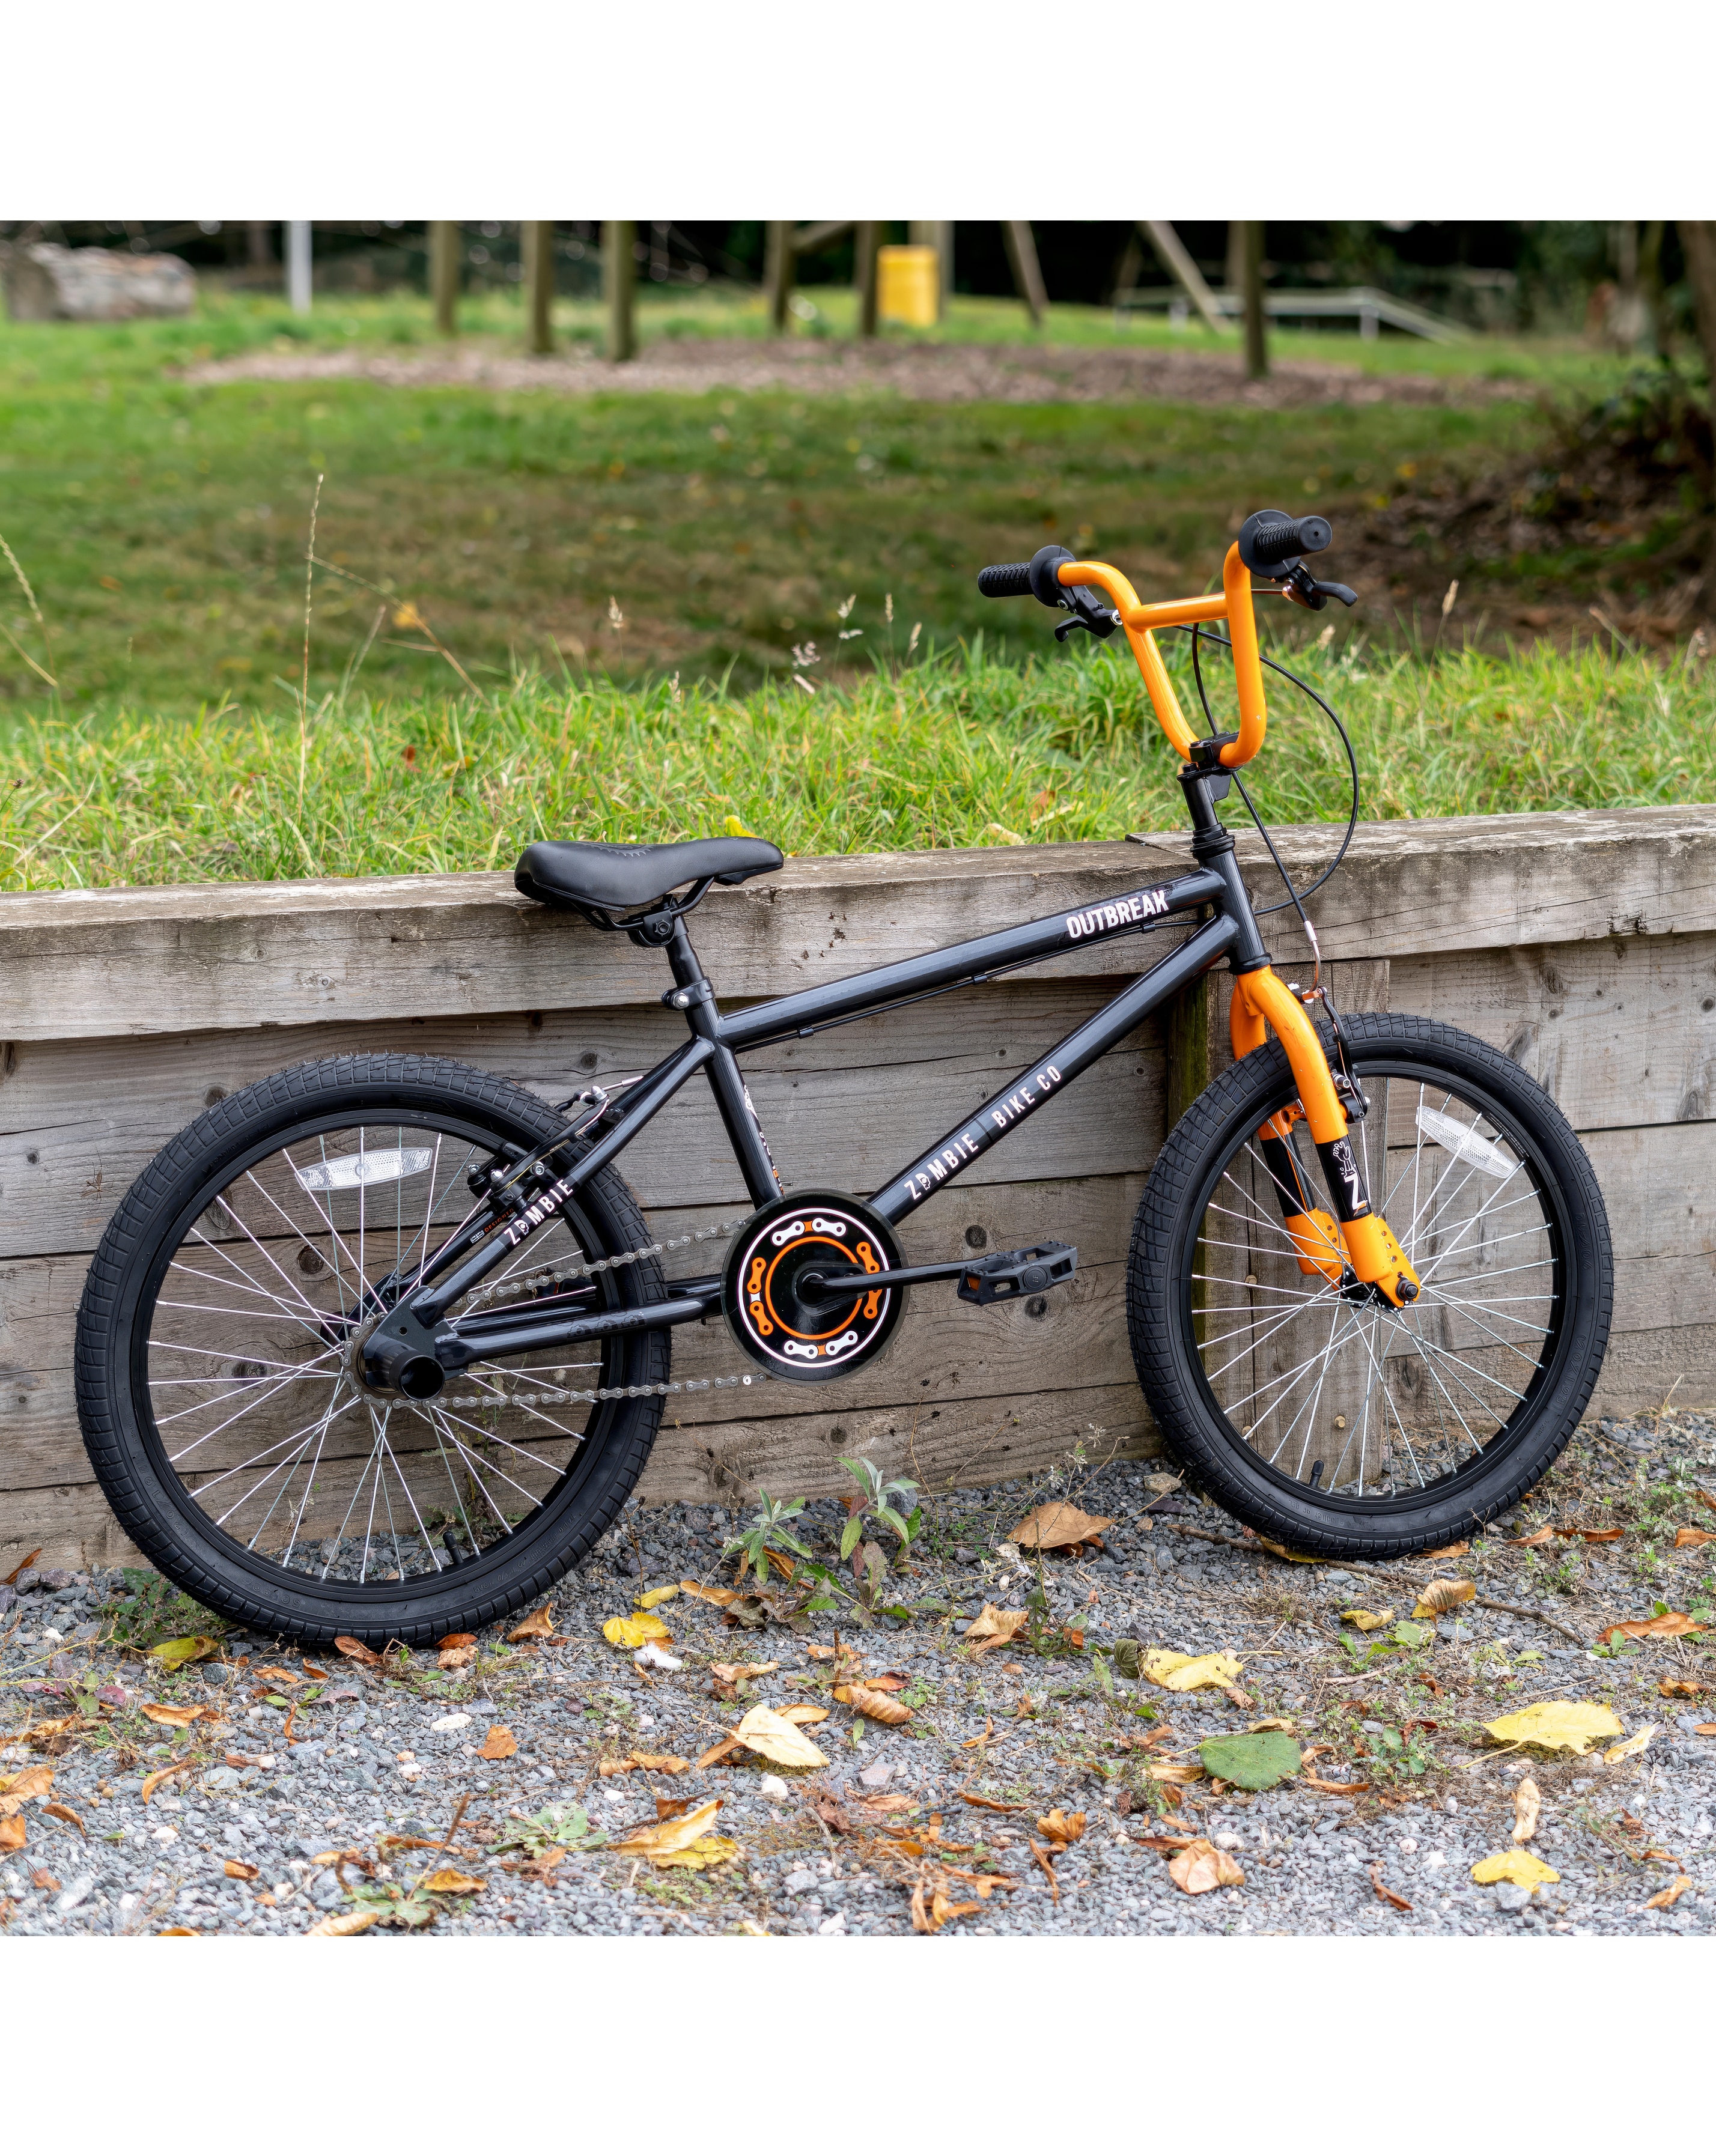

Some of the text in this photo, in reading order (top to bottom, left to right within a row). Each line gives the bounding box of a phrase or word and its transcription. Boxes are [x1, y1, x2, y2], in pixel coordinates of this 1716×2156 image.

[1066, 890, 1169, 938] OUTBREAK
[904, 1066, 1062, 1200] ZOMBIE BIKE CO
[504, 1179, 573, 1246] ZOMBIE
